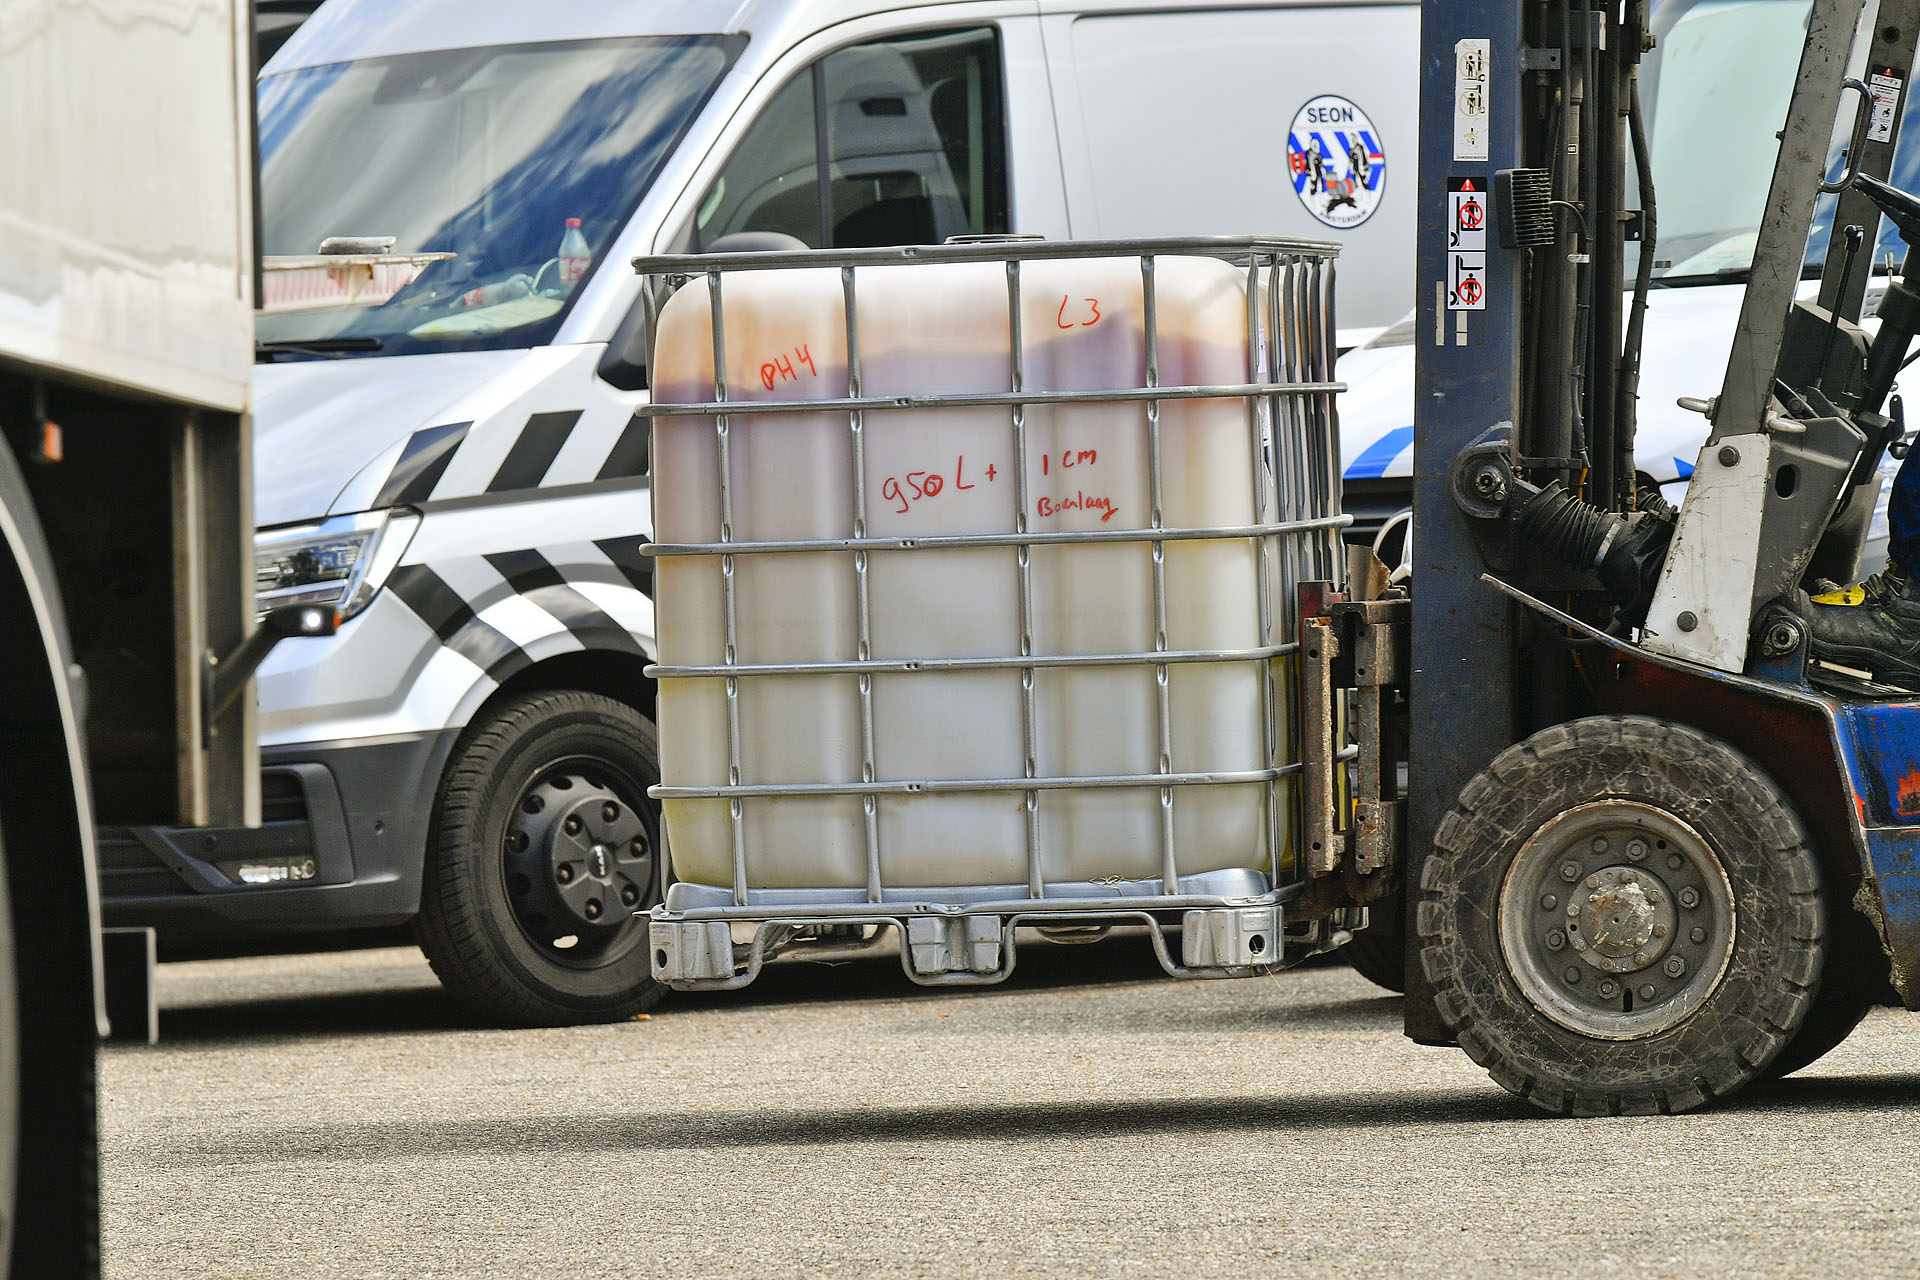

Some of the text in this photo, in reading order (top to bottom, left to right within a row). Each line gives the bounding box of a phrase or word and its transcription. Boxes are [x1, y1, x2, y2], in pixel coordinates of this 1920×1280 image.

[1307, 107, 1354, 123] SEON
[883, 471, 944, 514] 950
[1043, 454, 1049, 476] 1
[1062, 449, 1097, 468] cm
